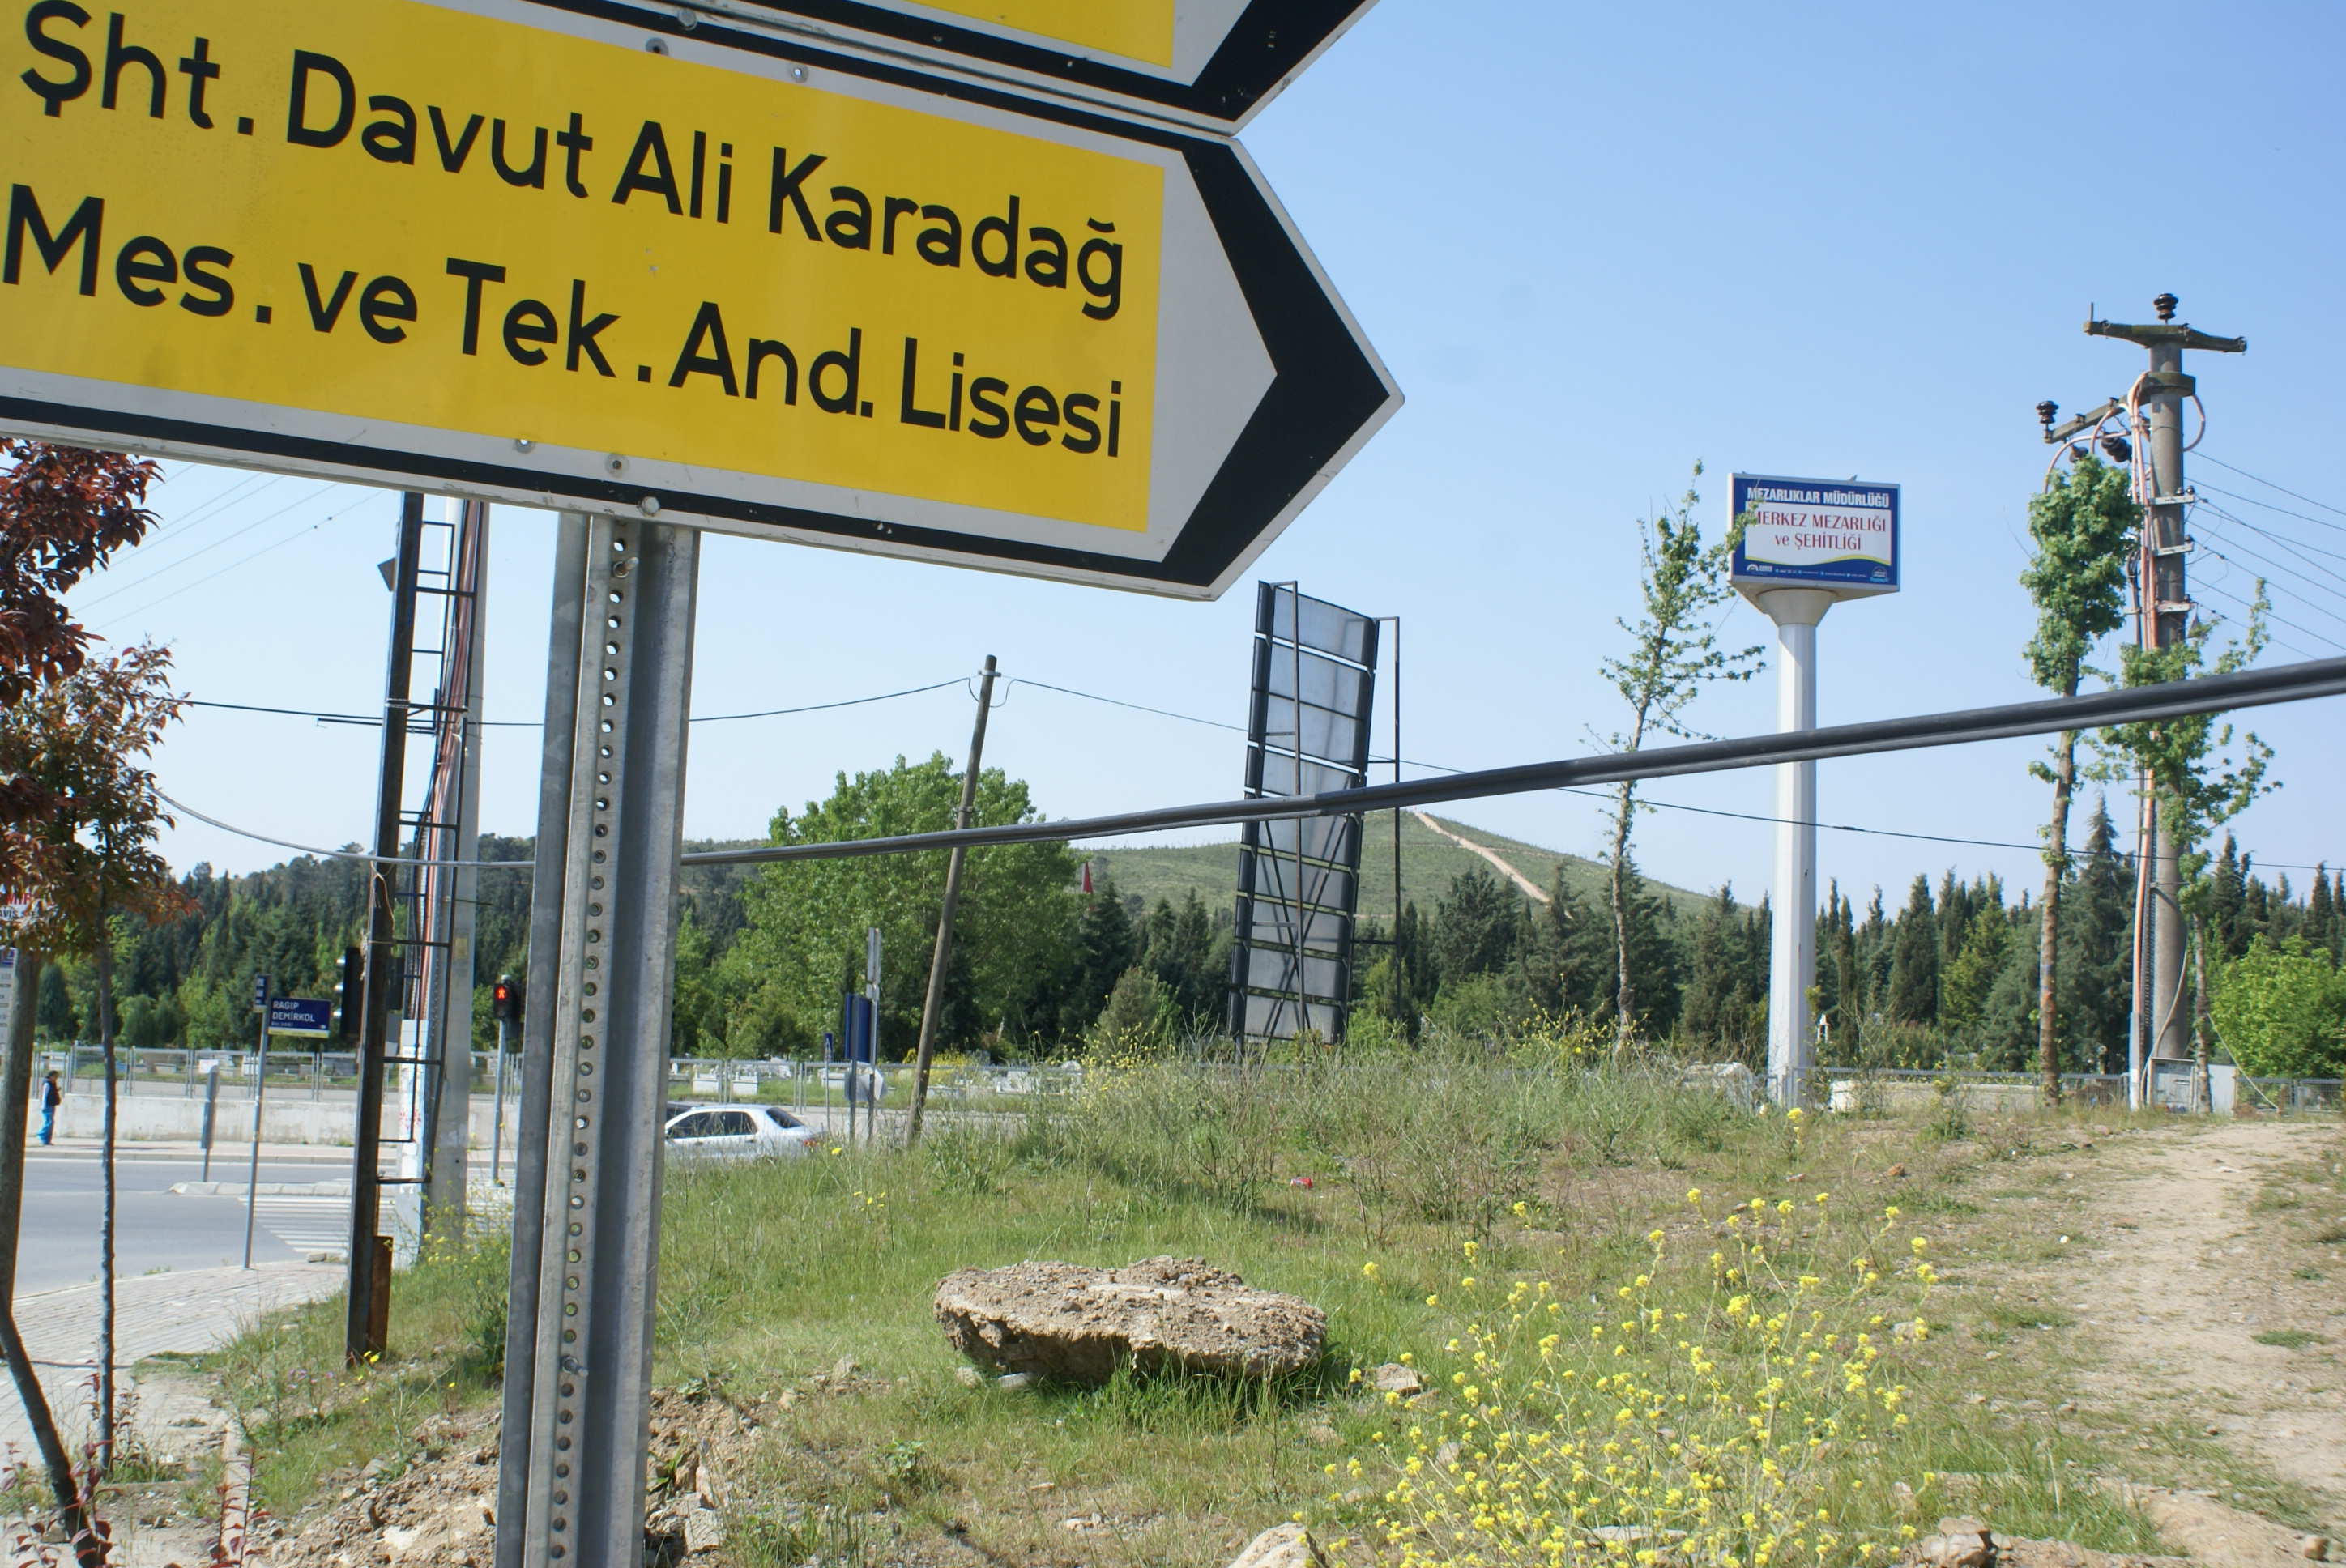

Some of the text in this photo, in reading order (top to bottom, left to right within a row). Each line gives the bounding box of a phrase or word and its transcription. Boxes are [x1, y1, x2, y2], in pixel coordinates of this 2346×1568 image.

[19, 0, 1123, 321] Şht. Davut Ali Karadağ
[2, 183, 1122, 458] Mes. ve Tek. And. Lisesi
[1747, 487, 1889, 508] MEZARLIKLAR MÜDÜRLÜĞÜ
[1812, 513, 1886, 532] MEZARLIĞI
[1775, 531, 1861, 551] ve ŞEHİTLİĞİ
[272, 1011, 315, 1022] DEMİRKOL
